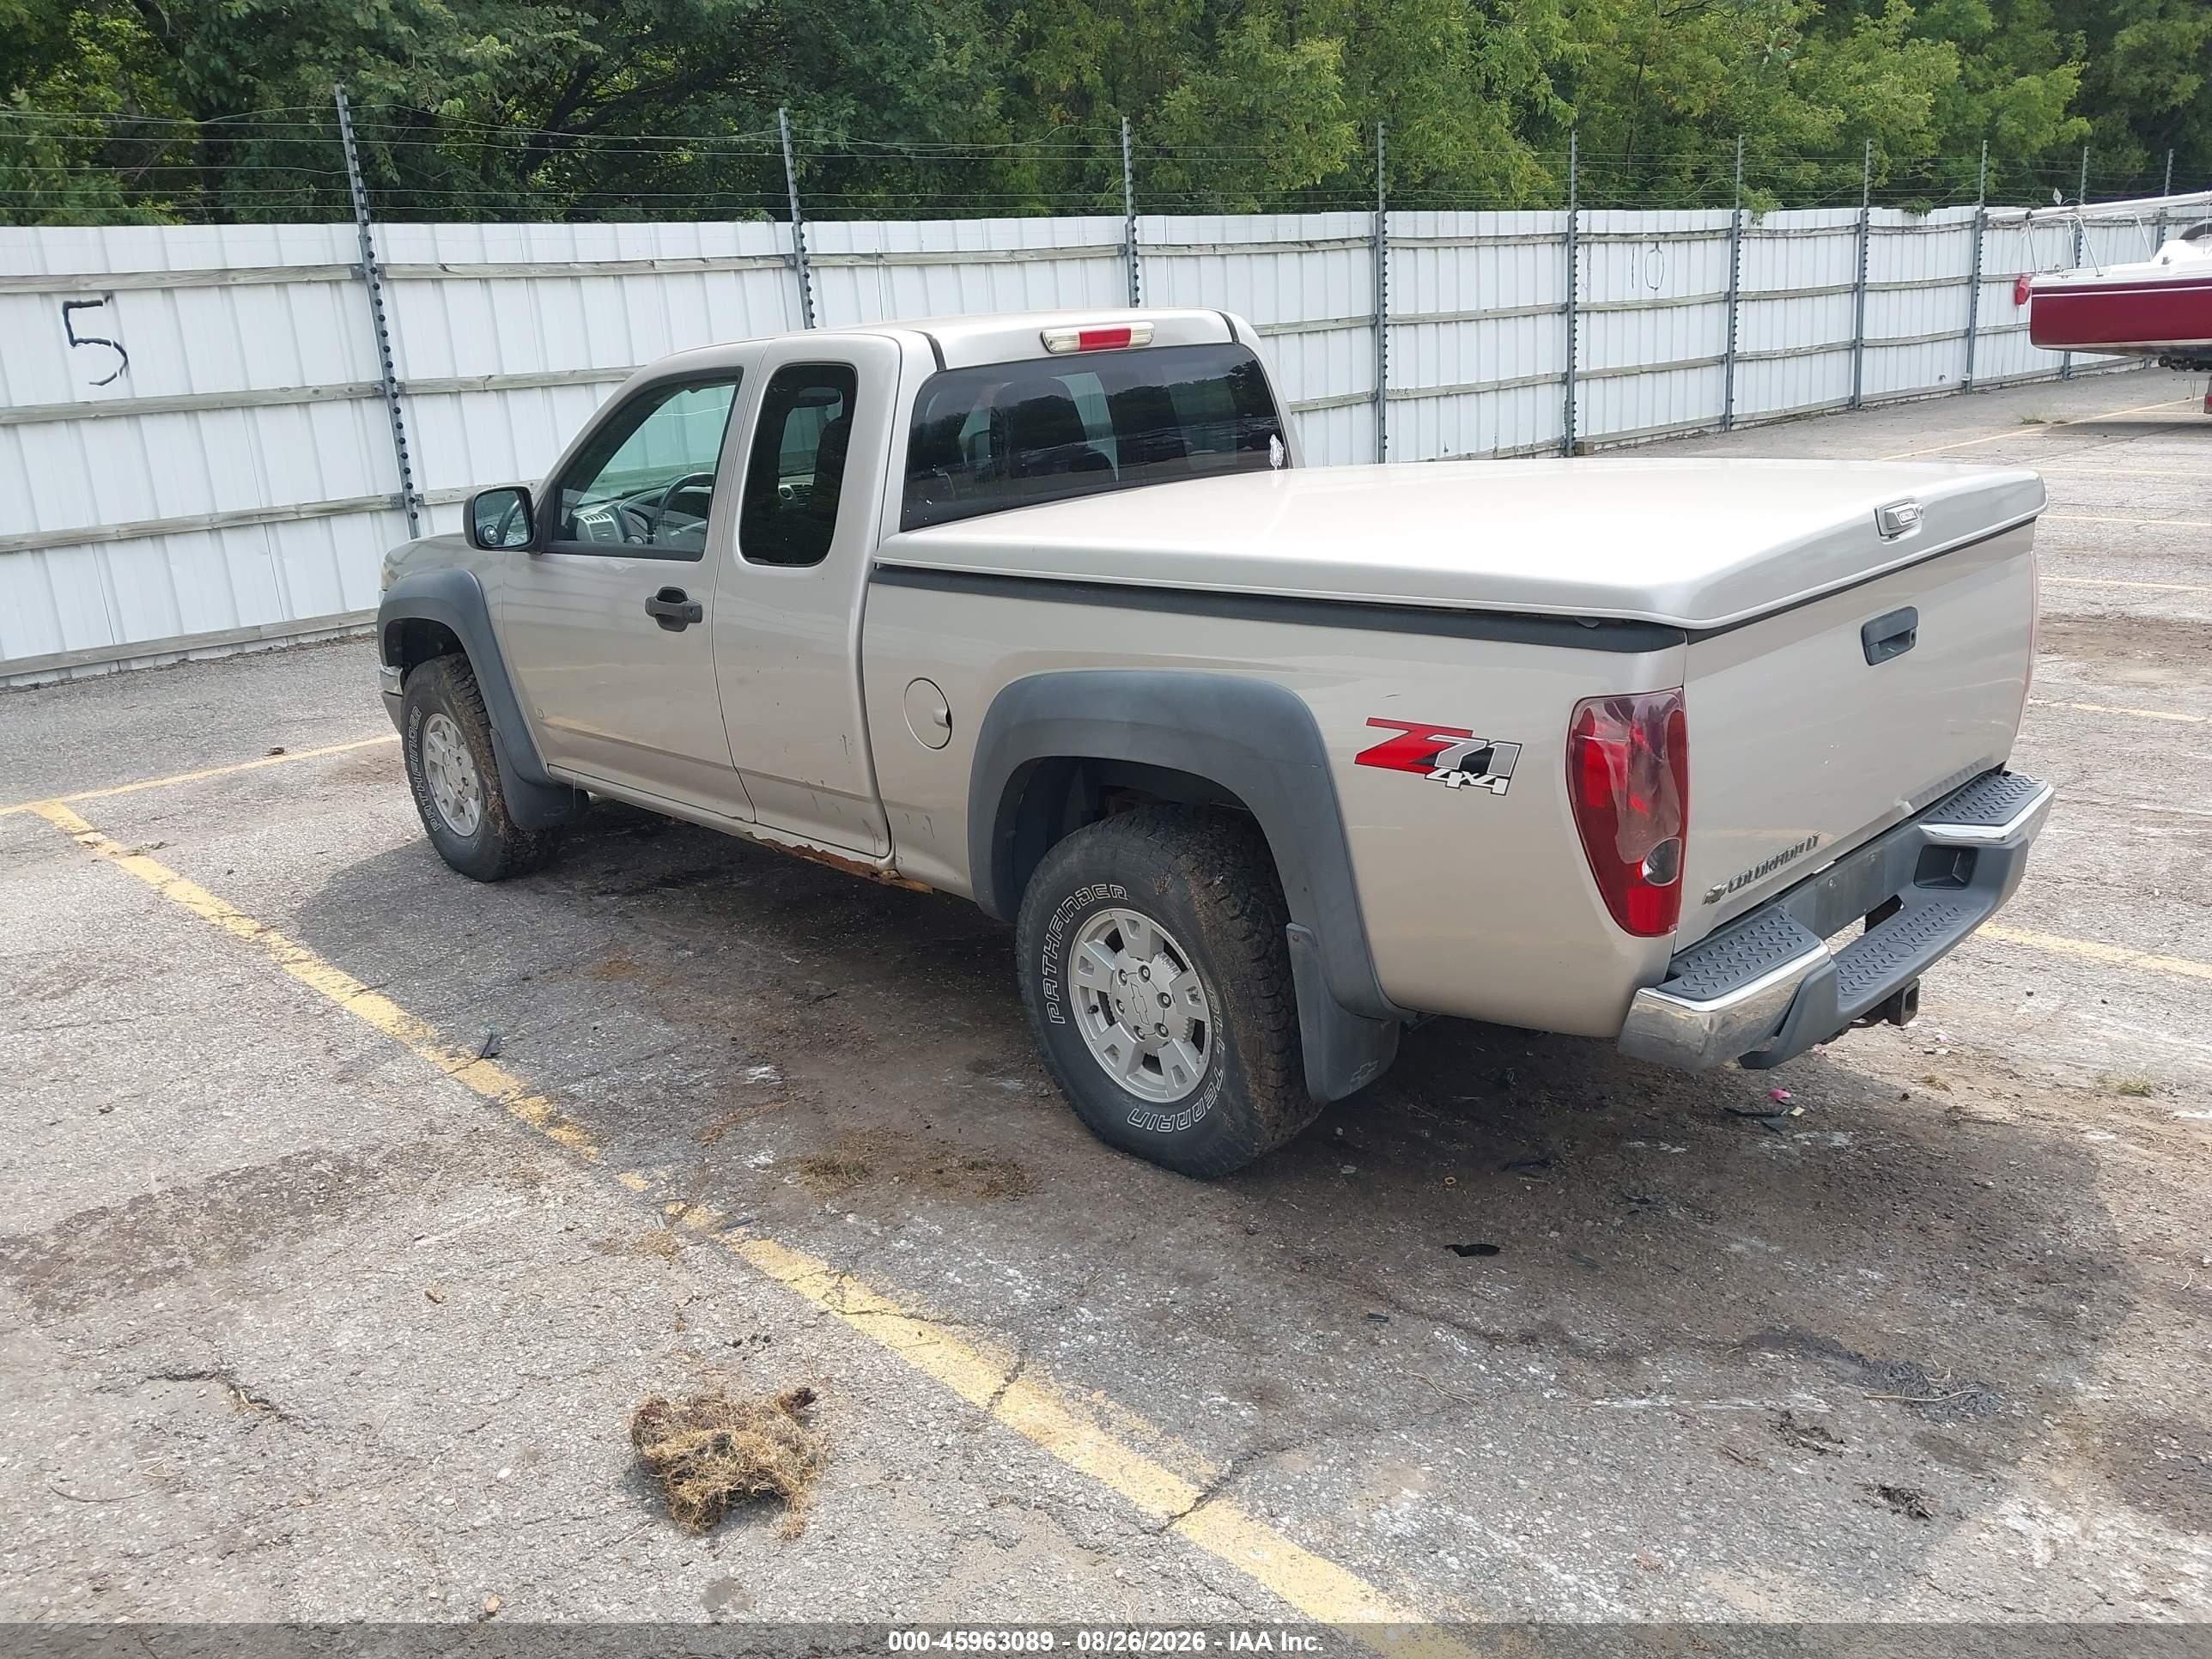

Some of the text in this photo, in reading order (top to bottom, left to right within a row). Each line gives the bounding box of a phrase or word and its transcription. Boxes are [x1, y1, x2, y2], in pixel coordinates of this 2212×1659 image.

[1631, 246, 1665, 292] 10
[62, 295, 129, 386] 5
[1354, 717, 1522, 779] Z71
[1728, 830, 1822, 894] COLORADO LT
[1042, 883, 1129, 1025] PATHFINDER
[1127, 988, 1226, 1133] ALL TERRAIN
